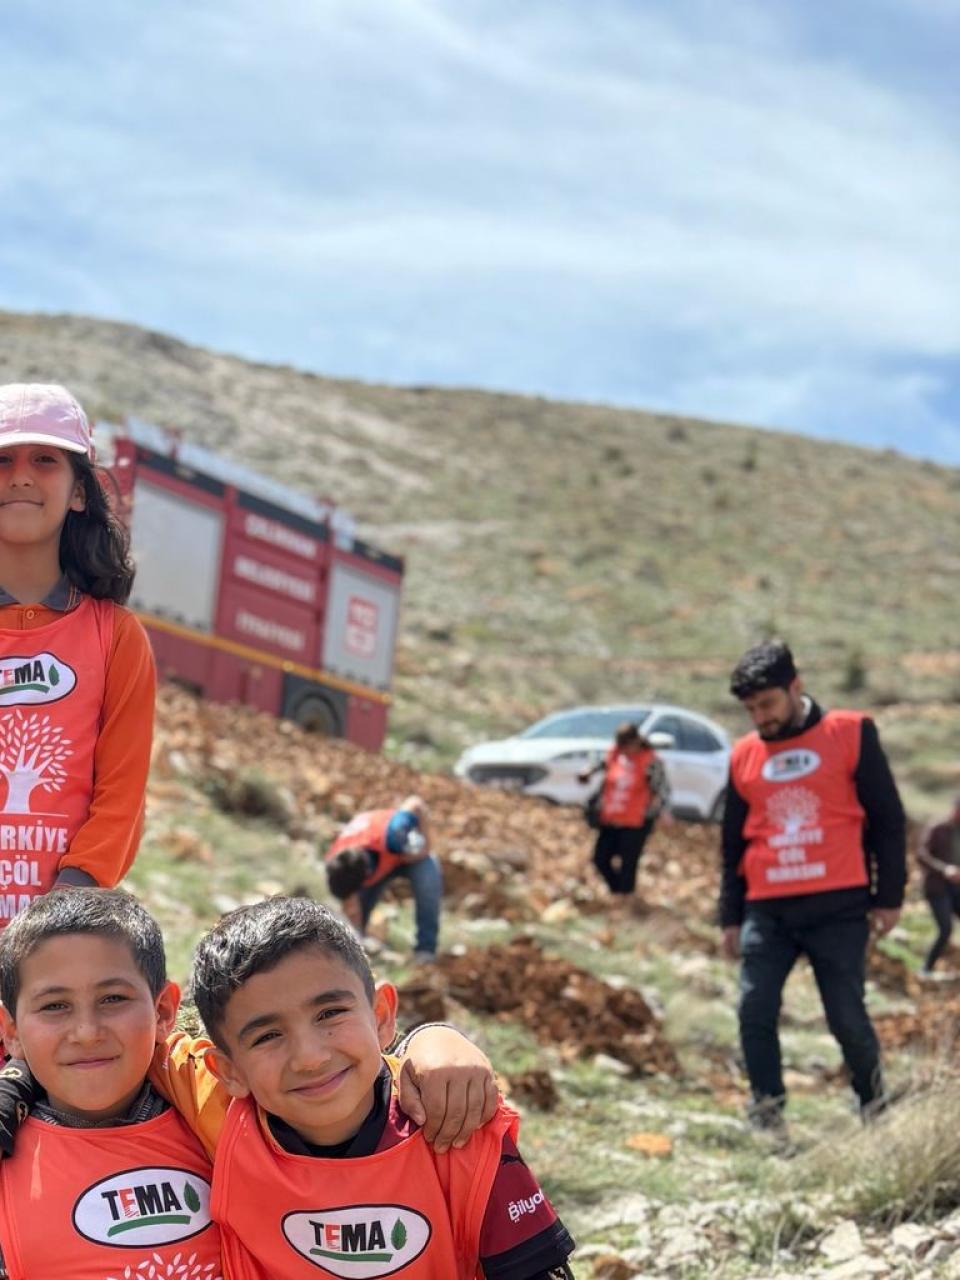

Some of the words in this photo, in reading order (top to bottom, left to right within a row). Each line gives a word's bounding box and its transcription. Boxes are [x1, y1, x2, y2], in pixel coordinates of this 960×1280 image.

[101, 1182, 183, 1221] TEMA
[508, 1187, 545, 1222] Bilyo
[308, 1220, 386, 1252] TEMA
